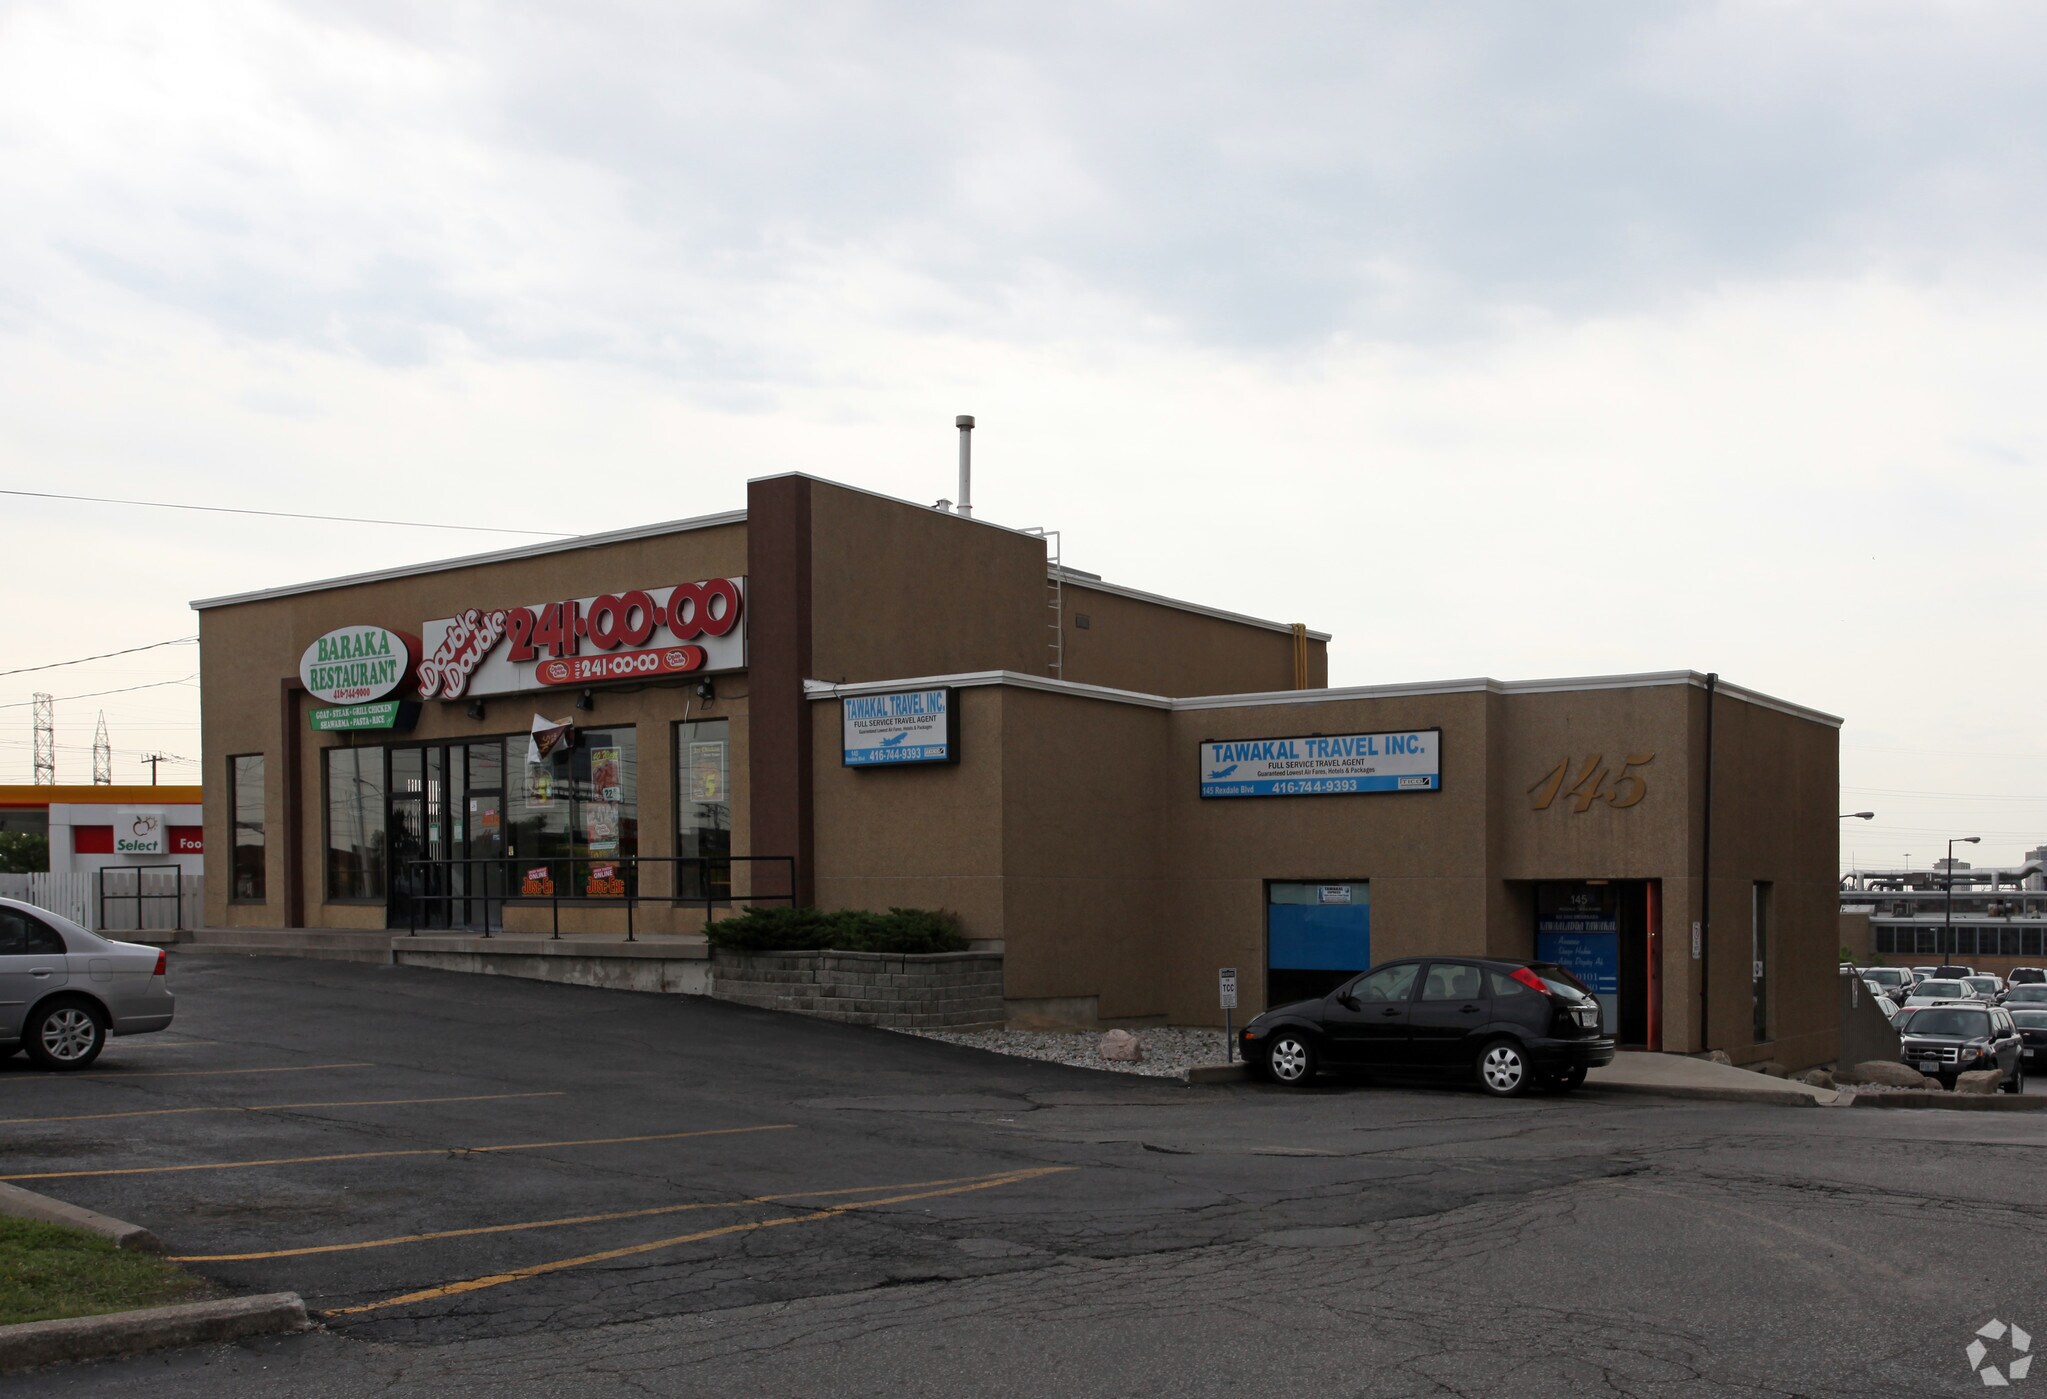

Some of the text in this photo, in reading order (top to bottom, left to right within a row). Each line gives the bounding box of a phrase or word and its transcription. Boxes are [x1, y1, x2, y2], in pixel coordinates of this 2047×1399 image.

[318, 630, 390, 662] BARAKA
[417, 608, 479, 698] Double
[442, 610, 505, 699] Double
[310, 660, 396, 691] RESTAURANT
[846, 691, 945, 719] TAWAKAL TRAVEL INC.
[315, 704, 392, 720] GOAT STEAK GRILL CHICKEN
[353, 717, 369, 726] PASTA
[372, 715, 385, 724] RICE
[854, 715, 936, 728] FULL SERVICE TRAVEL AGENT
[869, 747, 921, 761] 416-744-9393
[1212, 734, 1425, 763] TAWAKAL TRAVEL INC.
[1285, 760, 1314, 769] SERVICE
[1315, 759, 1340, 767] TRAVEL
[1341, 758, 1365, 766] AGENT
[1350, 767, 1375, 775] Packages
[1202, 784, 1254, 795] 145 Rexdale Blvd
[1272, 779, 1357, 793] 416-744-9393
[1527, 752, 1655, 814] 145
[117, 839, 158, 851] Select
[180, 838, 204, 849] Foo
[529, 872, 547, 880] ONLINE
[593, 870, 613, 879] ONLINE
[1570, 894, 1588, 904] 145
[1223, 984, 1235, 992] TCC
